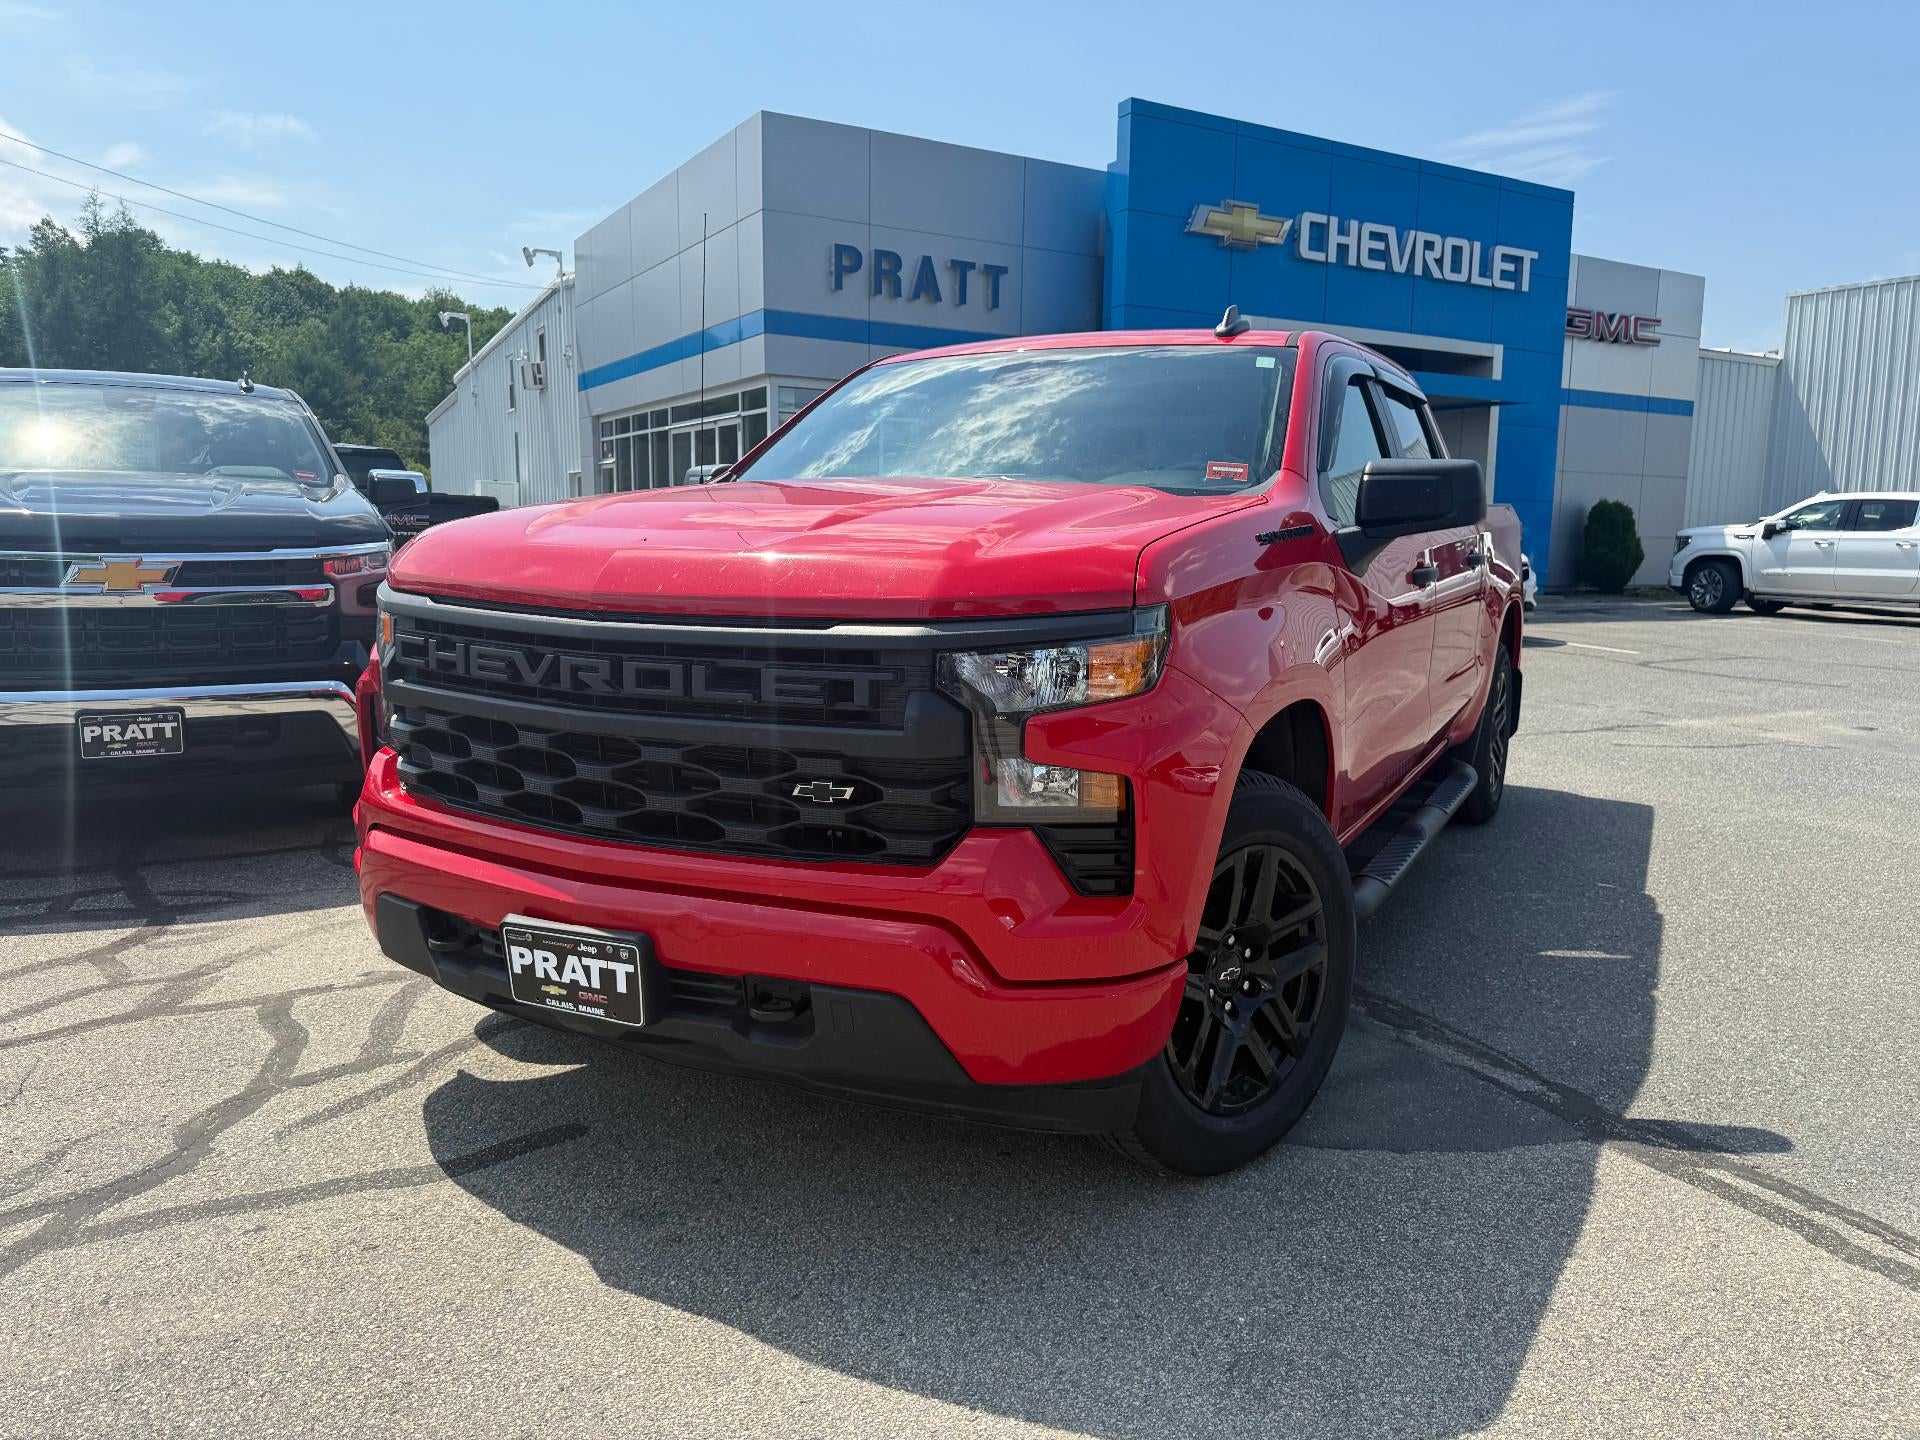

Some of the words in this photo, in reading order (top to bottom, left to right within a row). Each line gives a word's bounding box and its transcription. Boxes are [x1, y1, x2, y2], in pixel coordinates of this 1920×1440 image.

[1297, 210, 1539, 293] CHEVROLET
[830, 242, 1009, 310] PRATT
[1565, 306, 1662, 346] GMC
[384, 513, 430, 526] MC
[395, 633, 899, 707] CHEVROLET
[83, 722, 178, 743] PRATT
[577, 943, 598, 955] Jeep
[509, 945, 635, 994] PRATT
[545, 998, 577, 1012] CALAIS,
[578, 1004, 606, 1017] MAINE
[578, 991, 609, 1005] GMC
